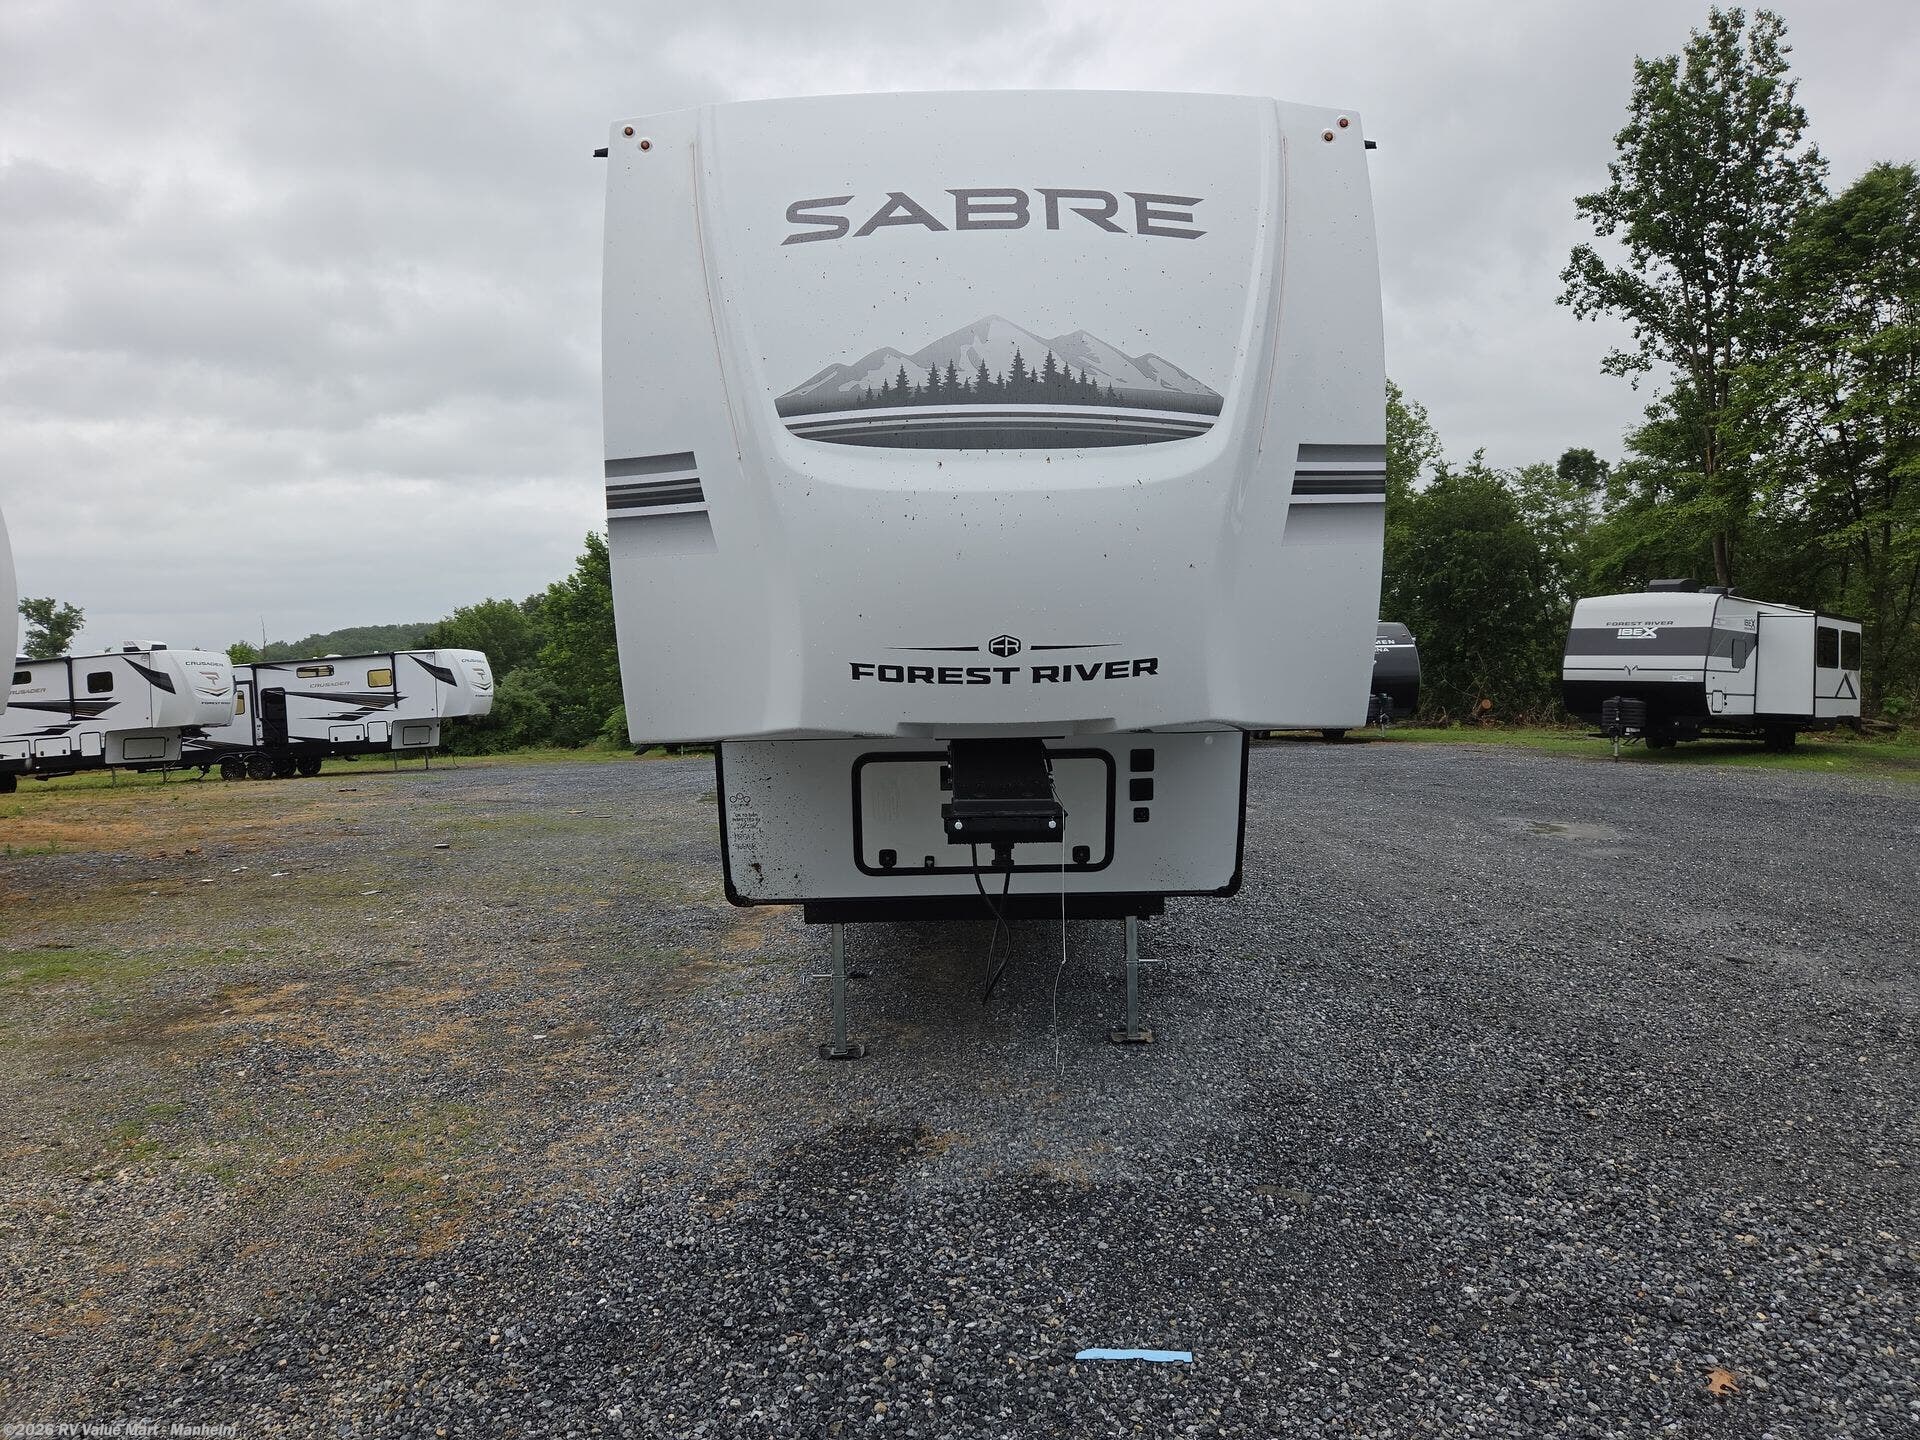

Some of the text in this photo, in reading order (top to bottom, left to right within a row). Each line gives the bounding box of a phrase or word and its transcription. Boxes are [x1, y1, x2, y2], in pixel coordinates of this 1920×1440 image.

[780, 188, 1208, 246] SABRE
[1617, 627, 1658, 638] IBEX
[849, 657, 1159, 685] FOREST RIVER
